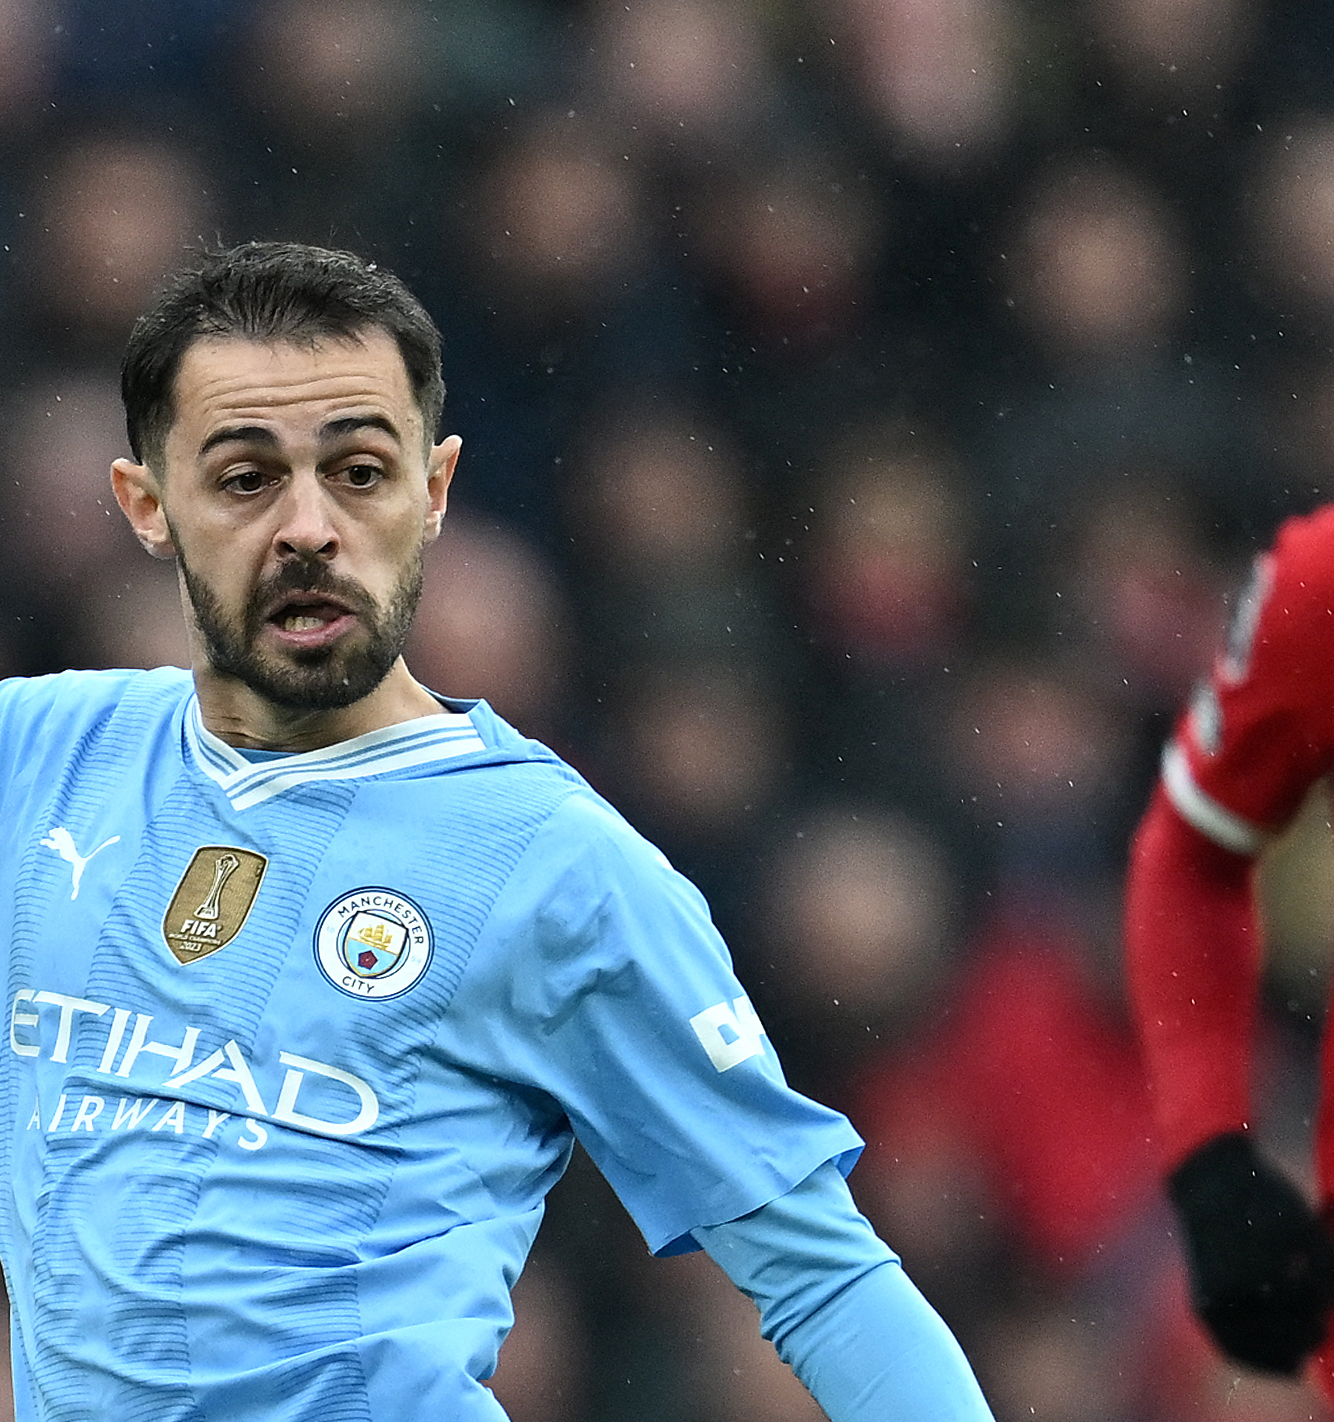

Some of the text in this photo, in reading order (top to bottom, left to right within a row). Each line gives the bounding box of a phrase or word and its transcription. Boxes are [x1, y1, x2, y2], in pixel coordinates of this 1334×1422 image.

[180, 919, 218, 938] FIFA
[337, 896, 424, 945] MANCHESTER
[342, 976, 374, 994] CITY
[10, 988, 379, 1136] ETIHAD
[26, 1094, 269, 1151] AIRWAYS
